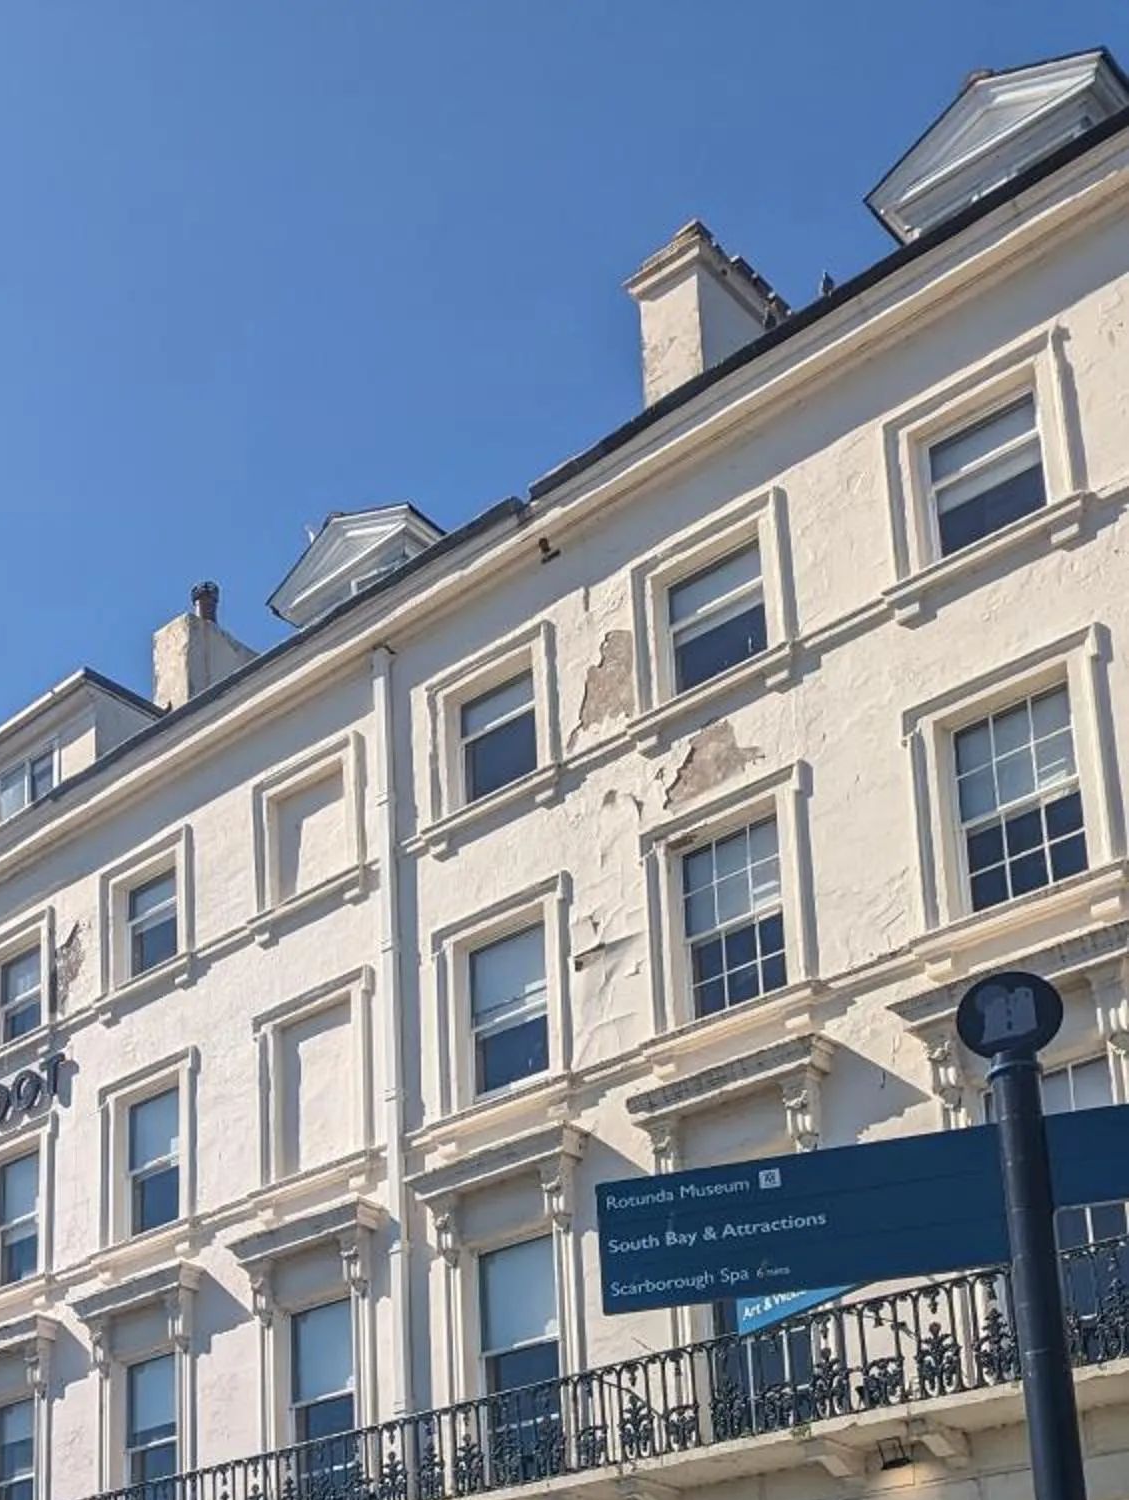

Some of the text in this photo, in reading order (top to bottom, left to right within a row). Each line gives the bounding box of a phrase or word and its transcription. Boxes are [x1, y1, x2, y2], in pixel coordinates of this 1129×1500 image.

[606, 1179, 750, 1211] Rotunda Museum
[608, 1213, 827, 1254] South Bay & Attractions
[610, 1269, 715, 1298] Scarborough
[720, 1267, 750, 1286] Spa
